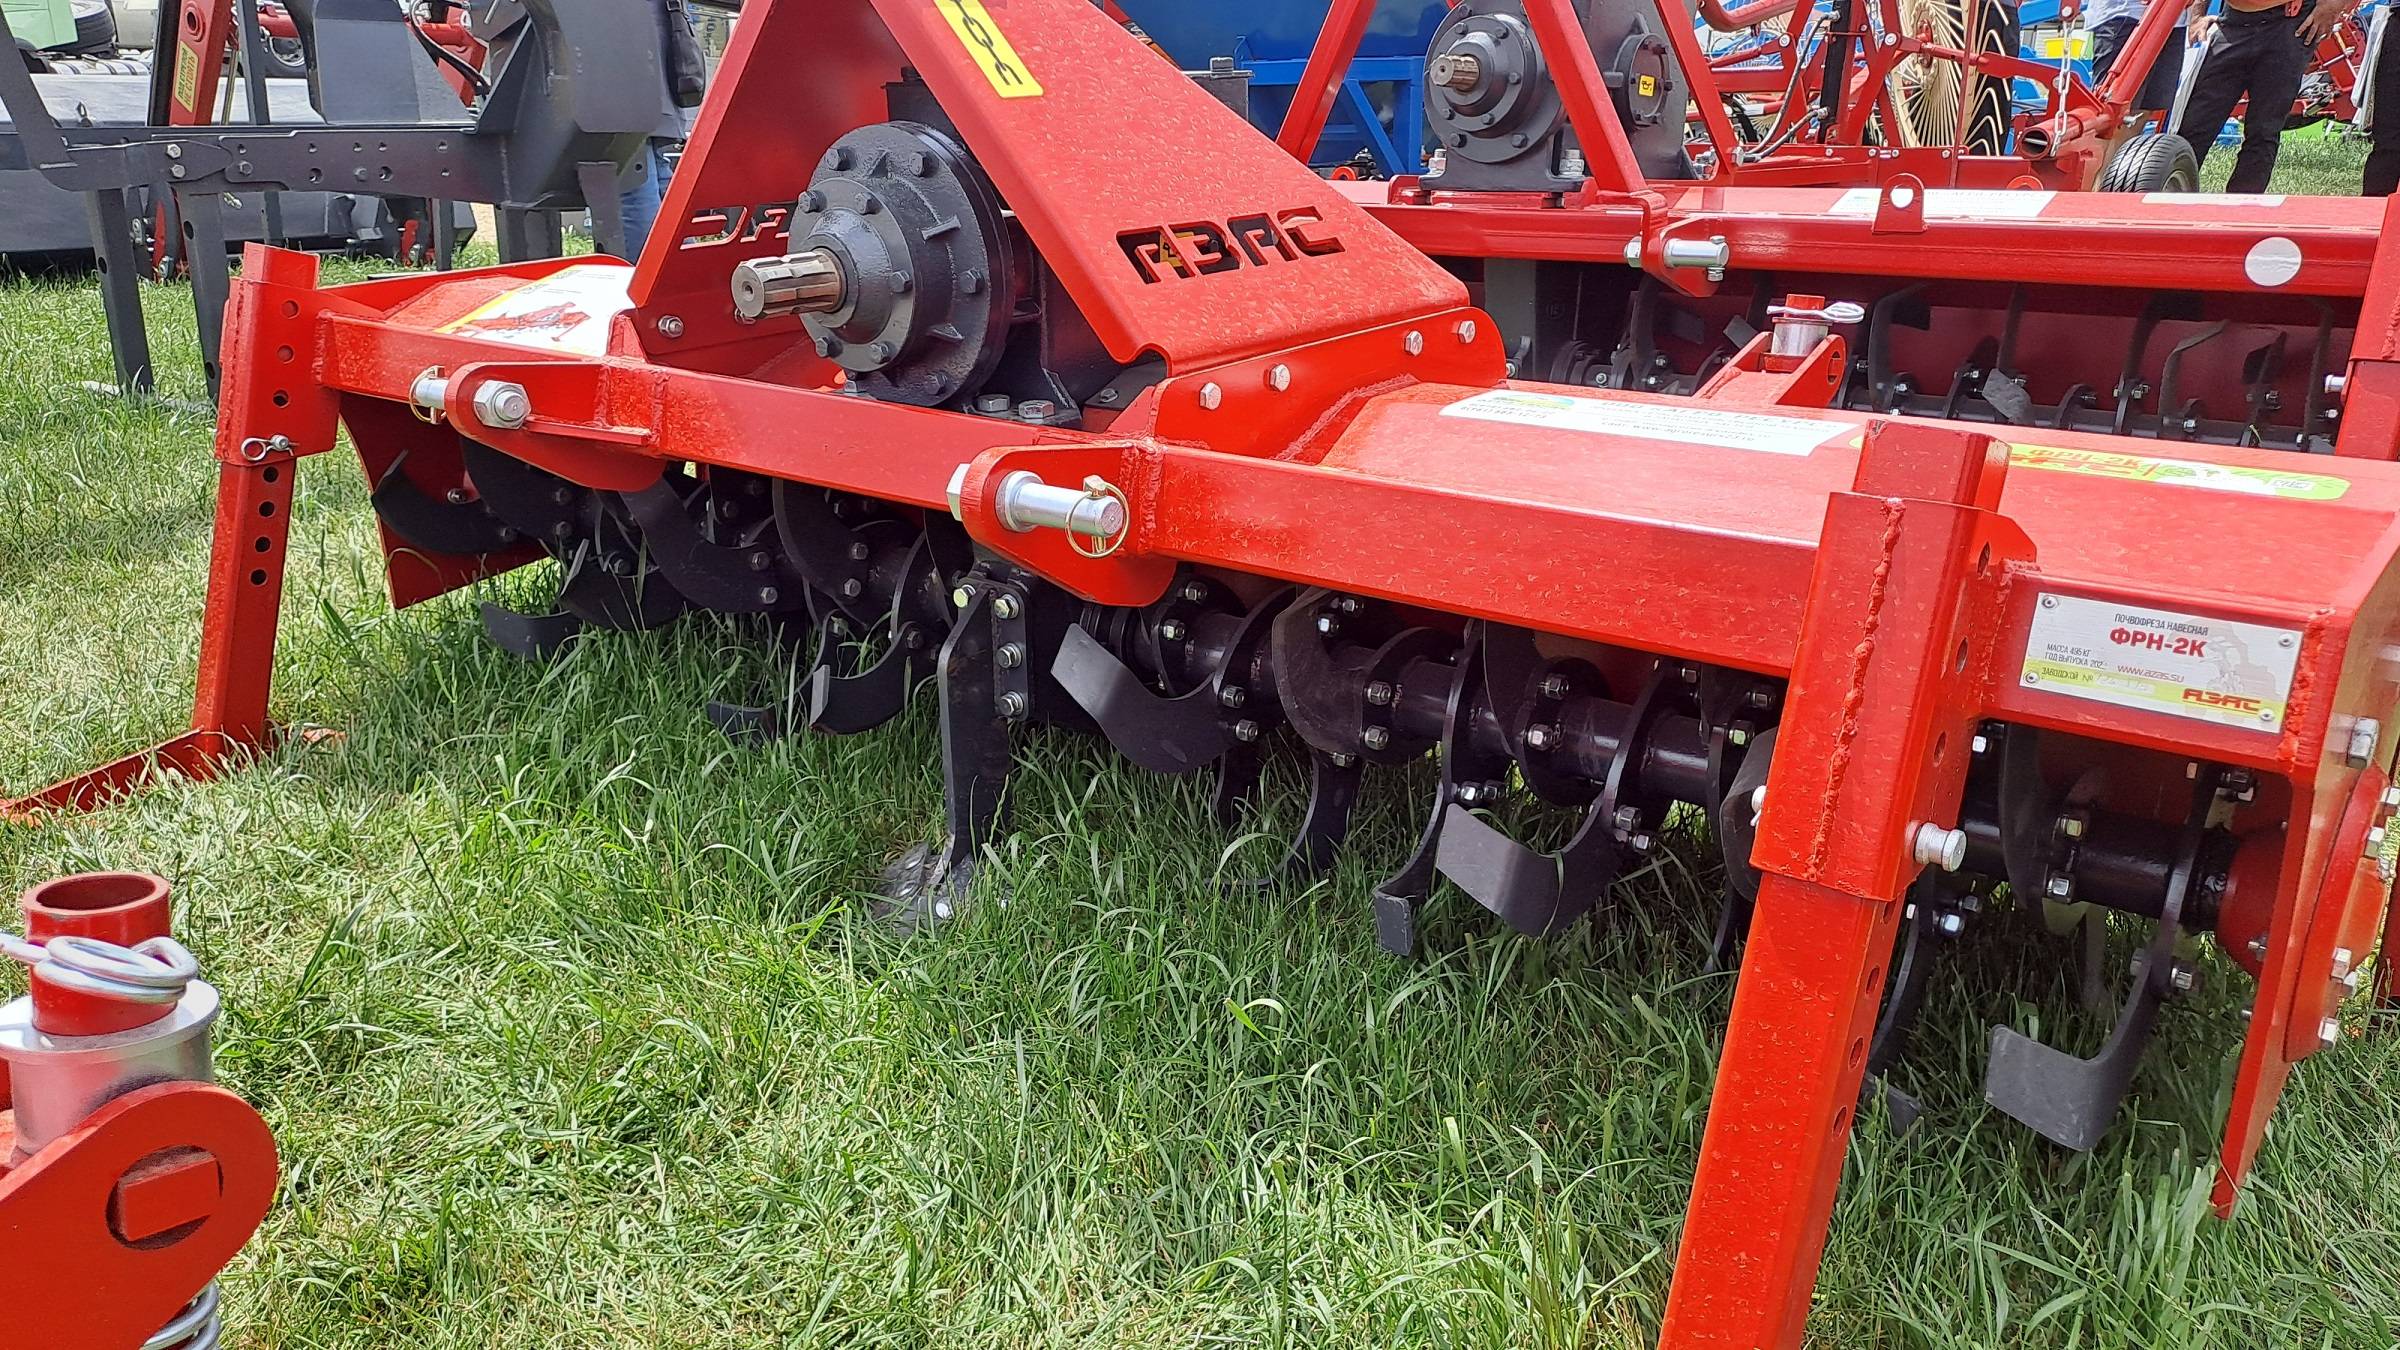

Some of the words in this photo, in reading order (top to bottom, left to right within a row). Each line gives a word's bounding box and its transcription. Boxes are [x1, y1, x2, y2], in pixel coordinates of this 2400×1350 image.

[1116, 205, 1346, 285] АЗАС
[2030, 449, 2140, 468] ФРН-2К
[2115, 613, 2165, 629] ПОЧВОФРЕЗА
[2166, 621, 2209, 636] НАВЕСНАЯ
[2046, 643, 2069, 653] МАССА
[2110, 627, 2207, 658] ФРН-2К
[2045, 652, 2058, 661] ГОД
[2059, 653, 2088, 666] ВЫПУСКА
[2117, 664, 2185, 683] www.azas.su
[2182, 688, 2261, 712] АЗАС
